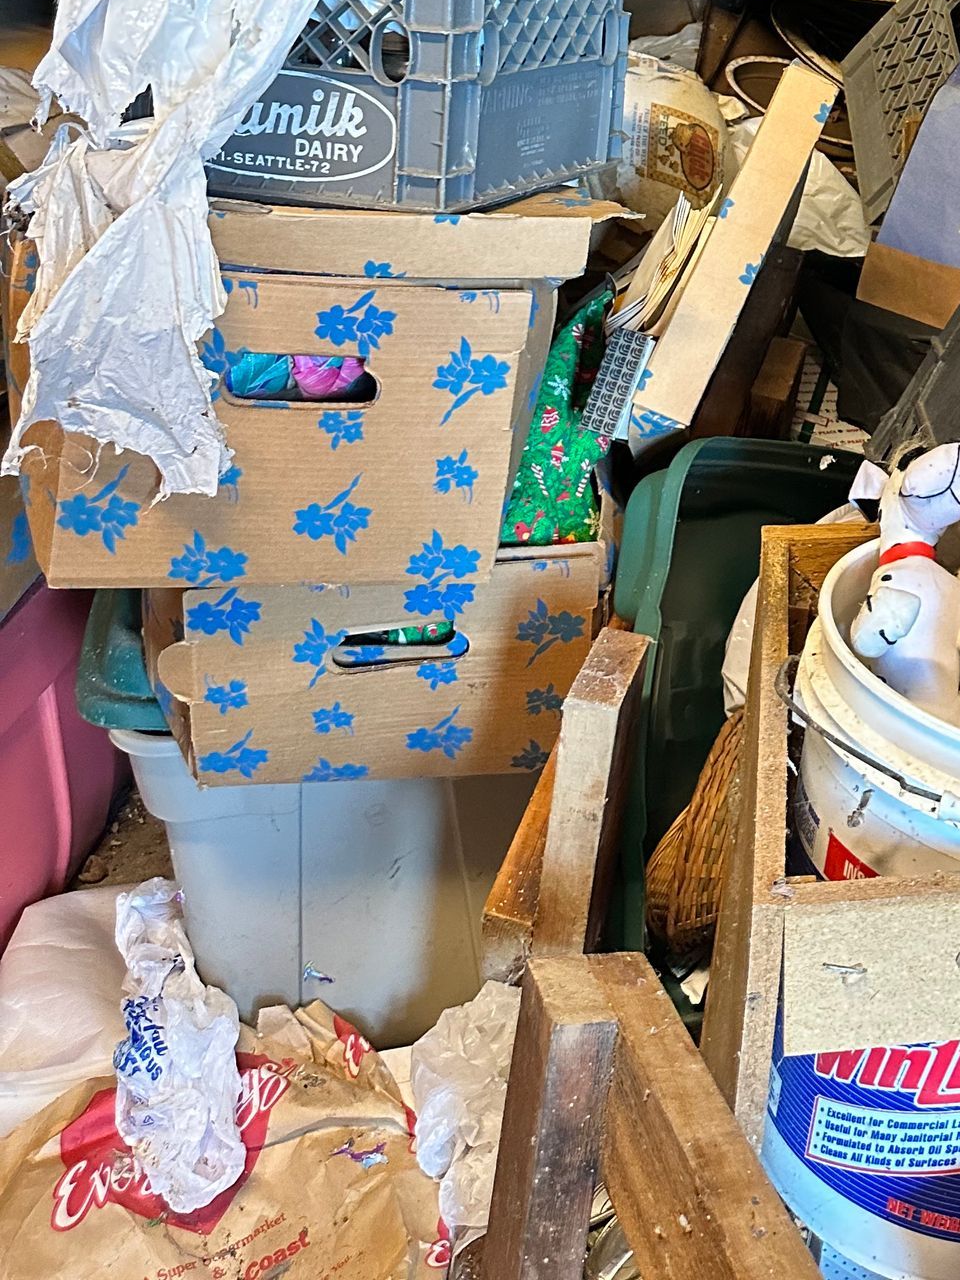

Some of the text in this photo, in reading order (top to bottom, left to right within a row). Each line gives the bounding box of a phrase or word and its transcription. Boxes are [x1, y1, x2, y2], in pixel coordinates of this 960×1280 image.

[234, 89, 367, 138] amilk
[659, 114, 669, 147] FEED
[295, 139, 363, 163] DAIRY
[827, 1107, 867, 1126] Excellent
[869, 1117, 884, 1127] for
[887, 1119, 949, 1130] Commercial
[822, 1132, 872, 1151] Formulated
[875, 1143, 885, 1153] to
[888, 1145, 924, 1155] Absorb
[928, 1145, 942, 1155] Oil
[825, 1120, 850, 1134] Useful
[854, 1127, 868, 1138] for
[871, 1131, 897, 1143] Many
[900, 1131, 953, 1143] Janitorial
[820, 1144, 848, 1160] Cleans
[850, 1152, 862, 1163] All
[865, 1155, 891, 1166] Kinds
[895, 1156, 905, 1167] of
[908, 1157, 957, 1168] Surfaces
[887, 1197, 914, 1221] NET
[157, 1259, 197, 1280] Super
